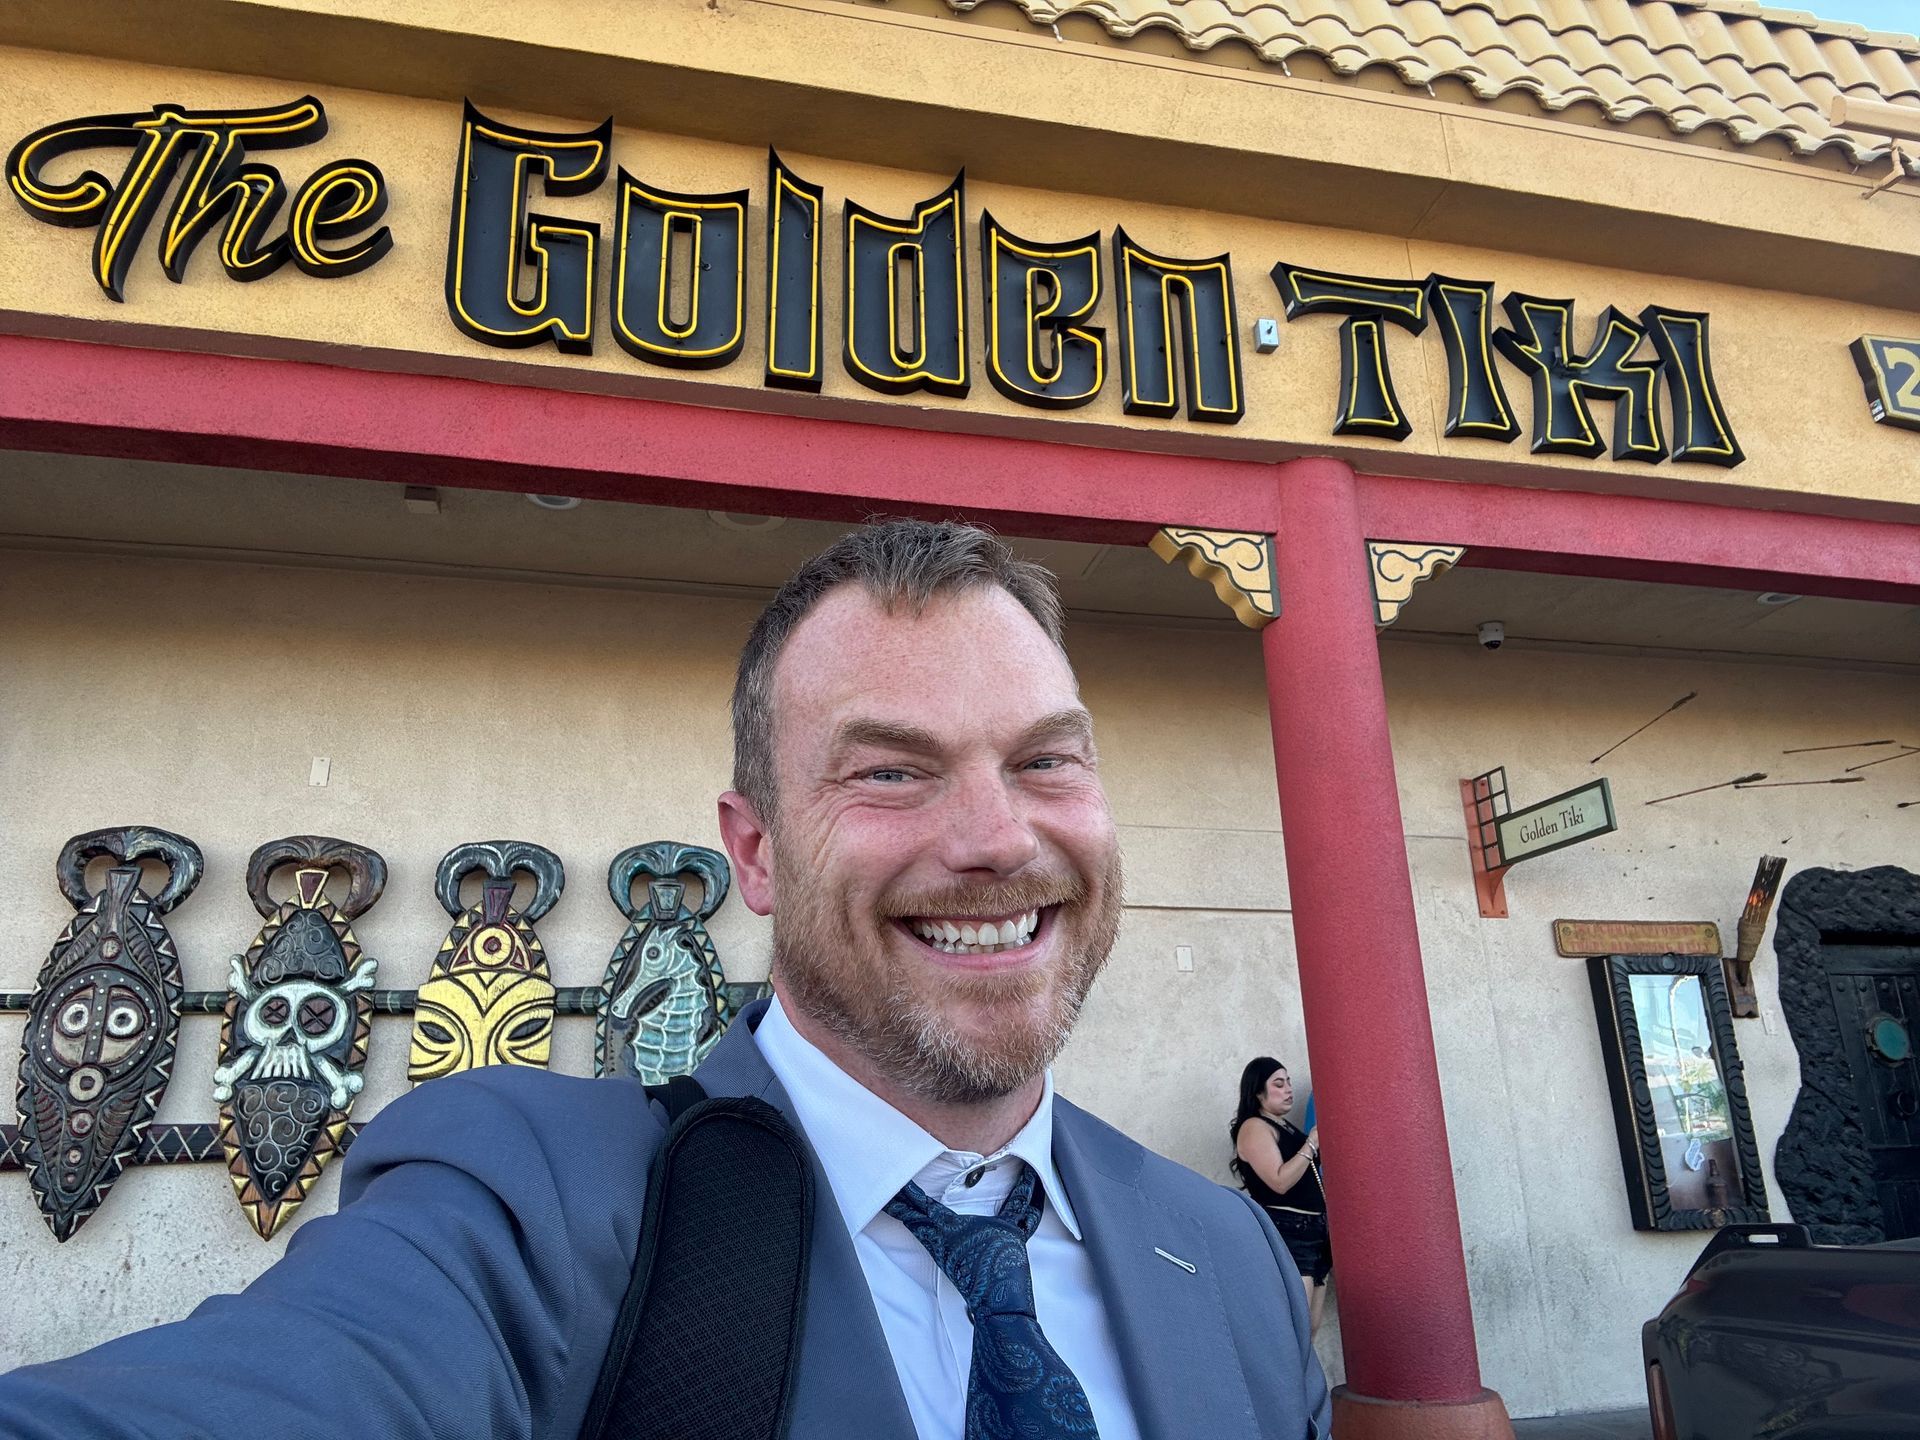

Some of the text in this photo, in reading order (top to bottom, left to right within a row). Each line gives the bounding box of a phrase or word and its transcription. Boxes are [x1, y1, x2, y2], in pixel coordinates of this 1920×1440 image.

[5, 94, 394, 303] The
[445, 97, 1245, 425] Golden
[1520, 805, 1585, 844] Golden Tiki
